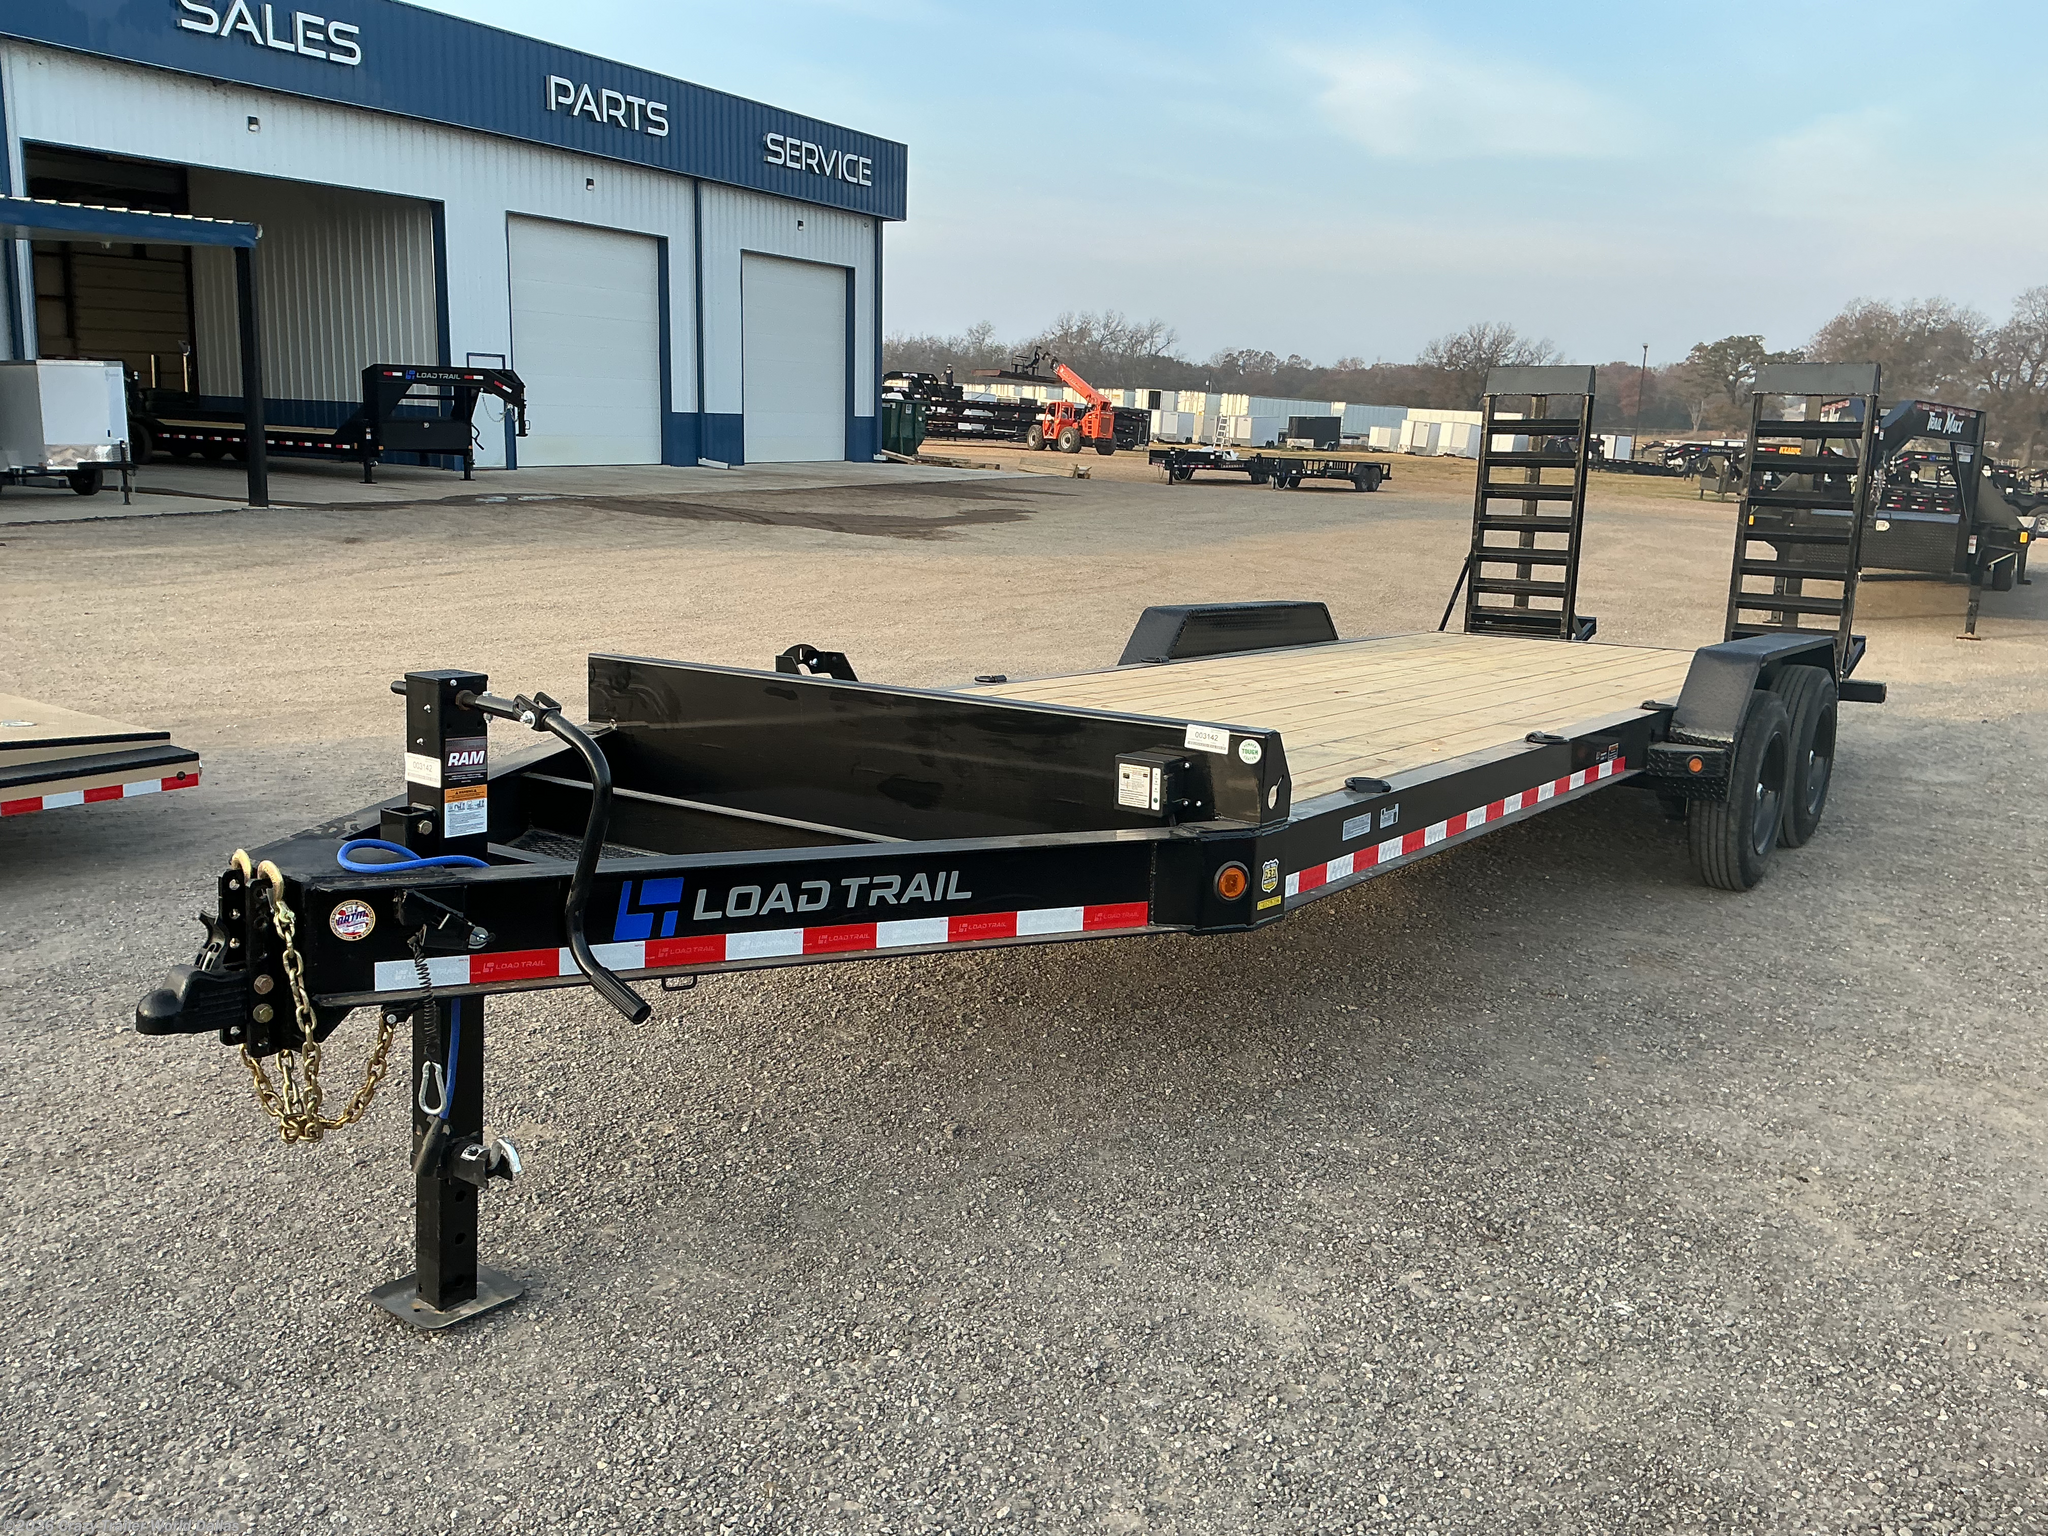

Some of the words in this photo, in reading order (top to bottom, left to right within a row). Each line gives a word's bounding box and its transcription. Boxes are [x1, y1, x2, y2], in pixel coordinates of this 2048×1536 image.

[180, 0, 361, 66] SALES
[549, 75, 669, 136] PARTS
[766, 132, 872, 187] SERVICE
[1195, 731, 1219, 741] 003142
[447, 750, 486, 767] RAM
[412, 760, 433, 773] 003142
[693, 879, 830, 920] LOAD
[841, 871, 972, 908] TRAIL
[1103, 913, 1121, 921] LOAD
[1121, 911, 1140, 919] TRAIL
[968, 922, 988, 930] LOAD
[988, 921, 1007, 929] TRAIL
[828, 934, 850, 942] LOAD
[850, 933, 870, 941] TRAIL
[670, 947, 692, 955] LOAD
[692, 945, 715, 953] TRAIL
[496, 961, 520, 971] LOAD
[520, 959, 546, 968] TRAIL
